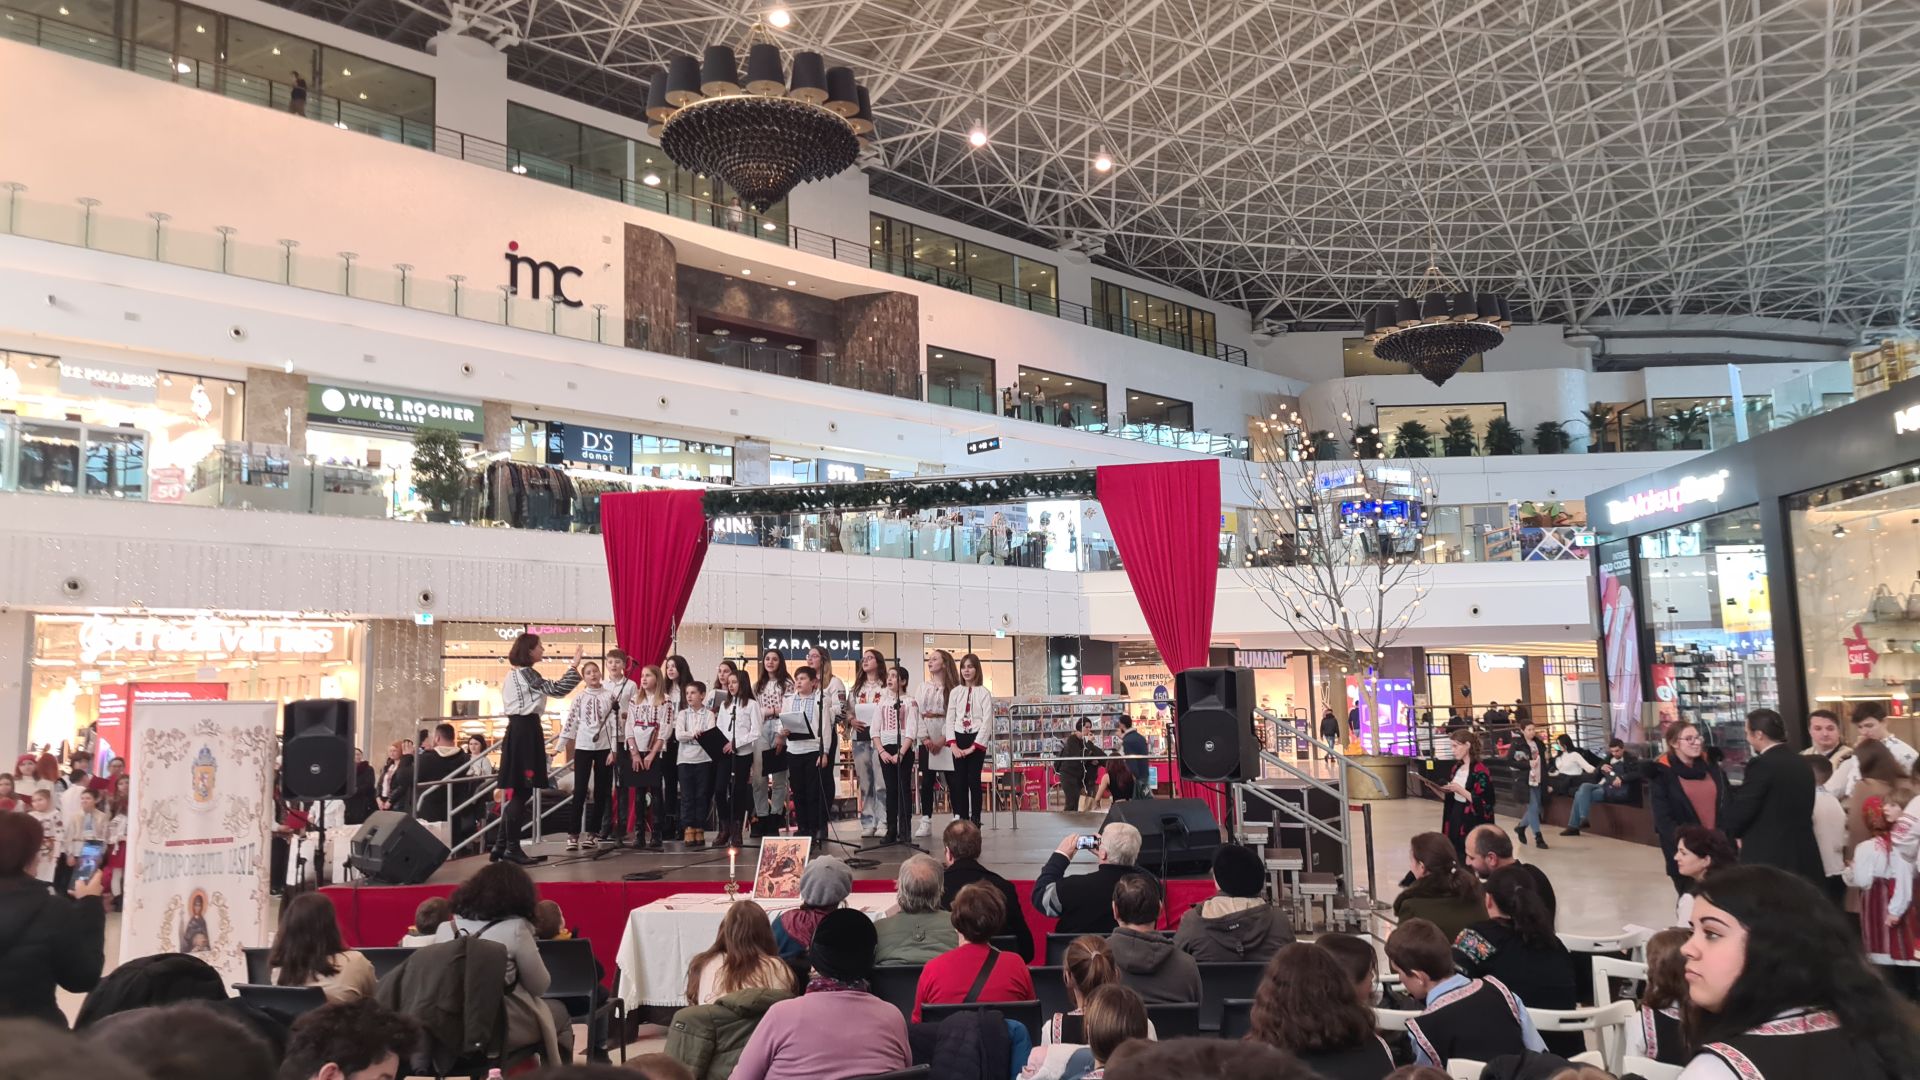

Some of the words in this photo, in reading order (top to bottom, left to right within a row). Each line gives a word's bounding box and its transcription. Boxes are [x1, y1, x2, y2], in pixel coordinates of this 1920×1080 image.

[348, 392, 395, 412] YVES
[402, 399, 475, 423] ROCHER
[379, 410, 425, 423] FRANCE
[582, 431, 613, 451] D'S
[581, 451, 613, 462] damat
[768, 638, 811, 650] ZARA
[819, 639, 861, 651] HOME
[1235, 651, 1287, 668] HUMANIC
[1849, 652, 1870, 665] SALE
